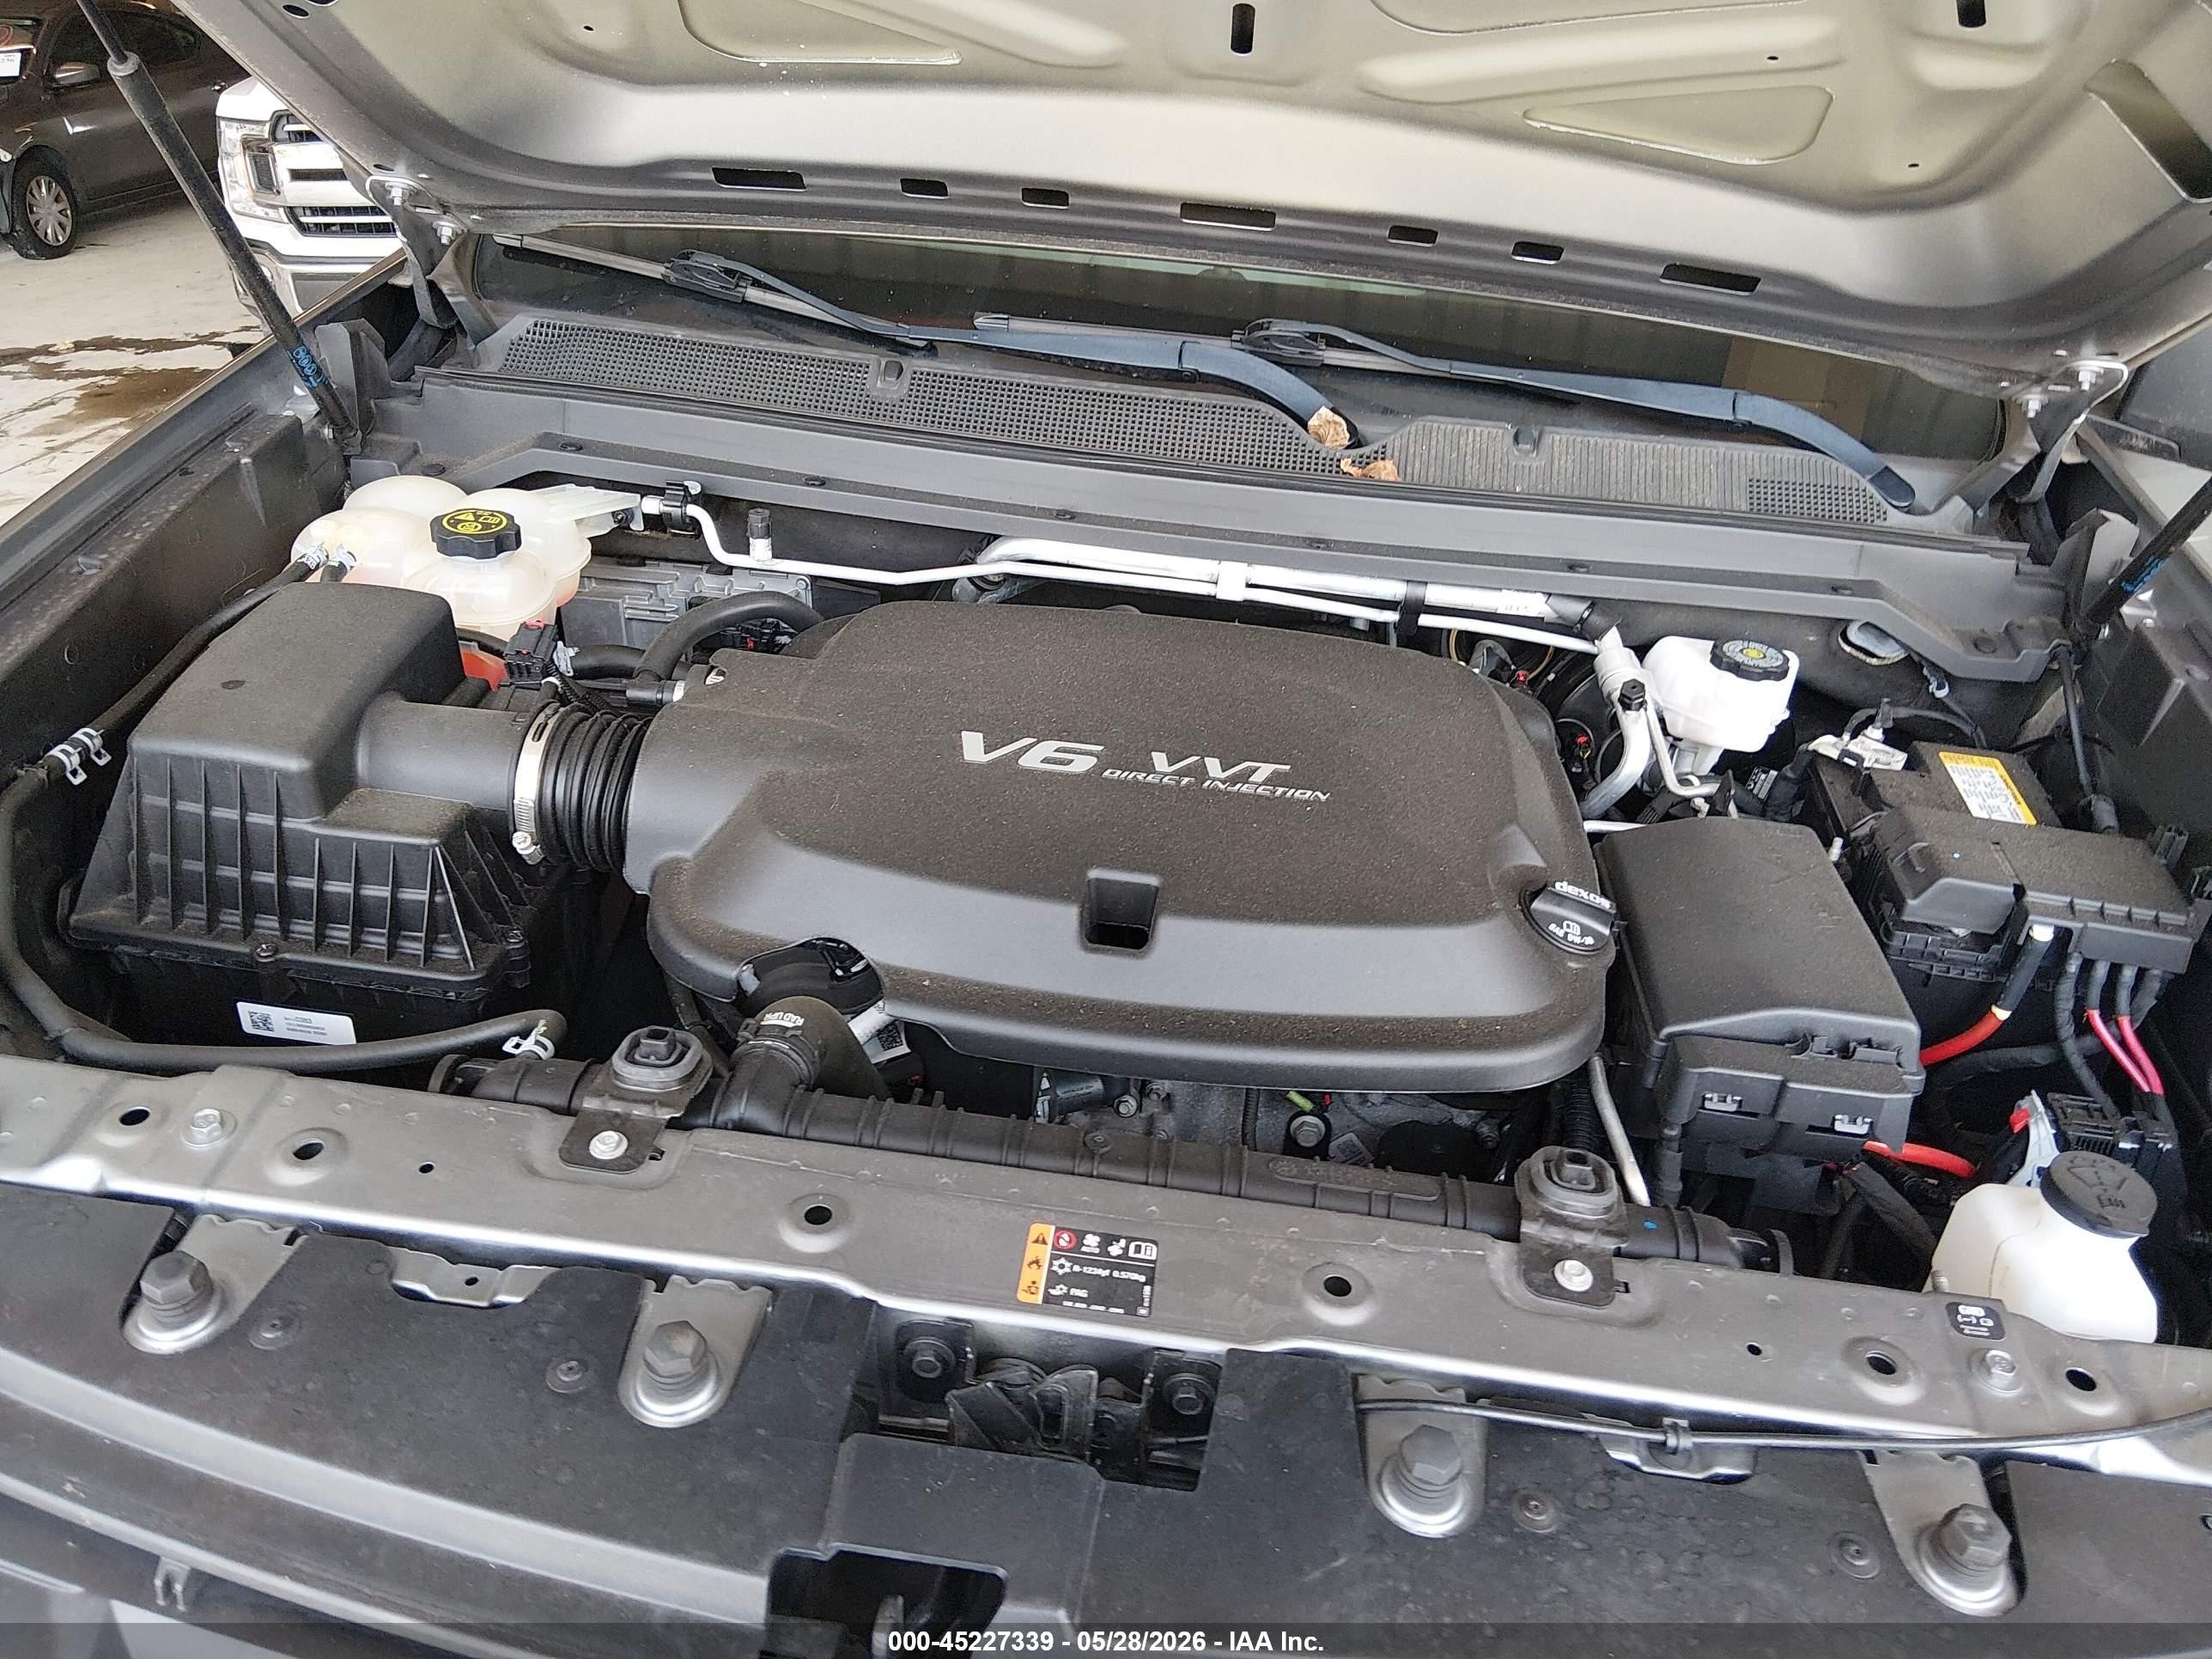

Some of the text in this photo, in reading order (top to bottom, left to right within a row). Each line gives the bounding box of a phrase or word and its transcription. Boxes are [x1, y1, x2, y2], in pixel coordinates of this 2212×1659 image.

[961, 731, 1291, 785] V6 VVT
[1101, 769, 1330, 802] DIRECT INJECTION
[783, 1012, 805, 1026] RAD
[1072, 1264, 1111, 1278] R-1234yf
